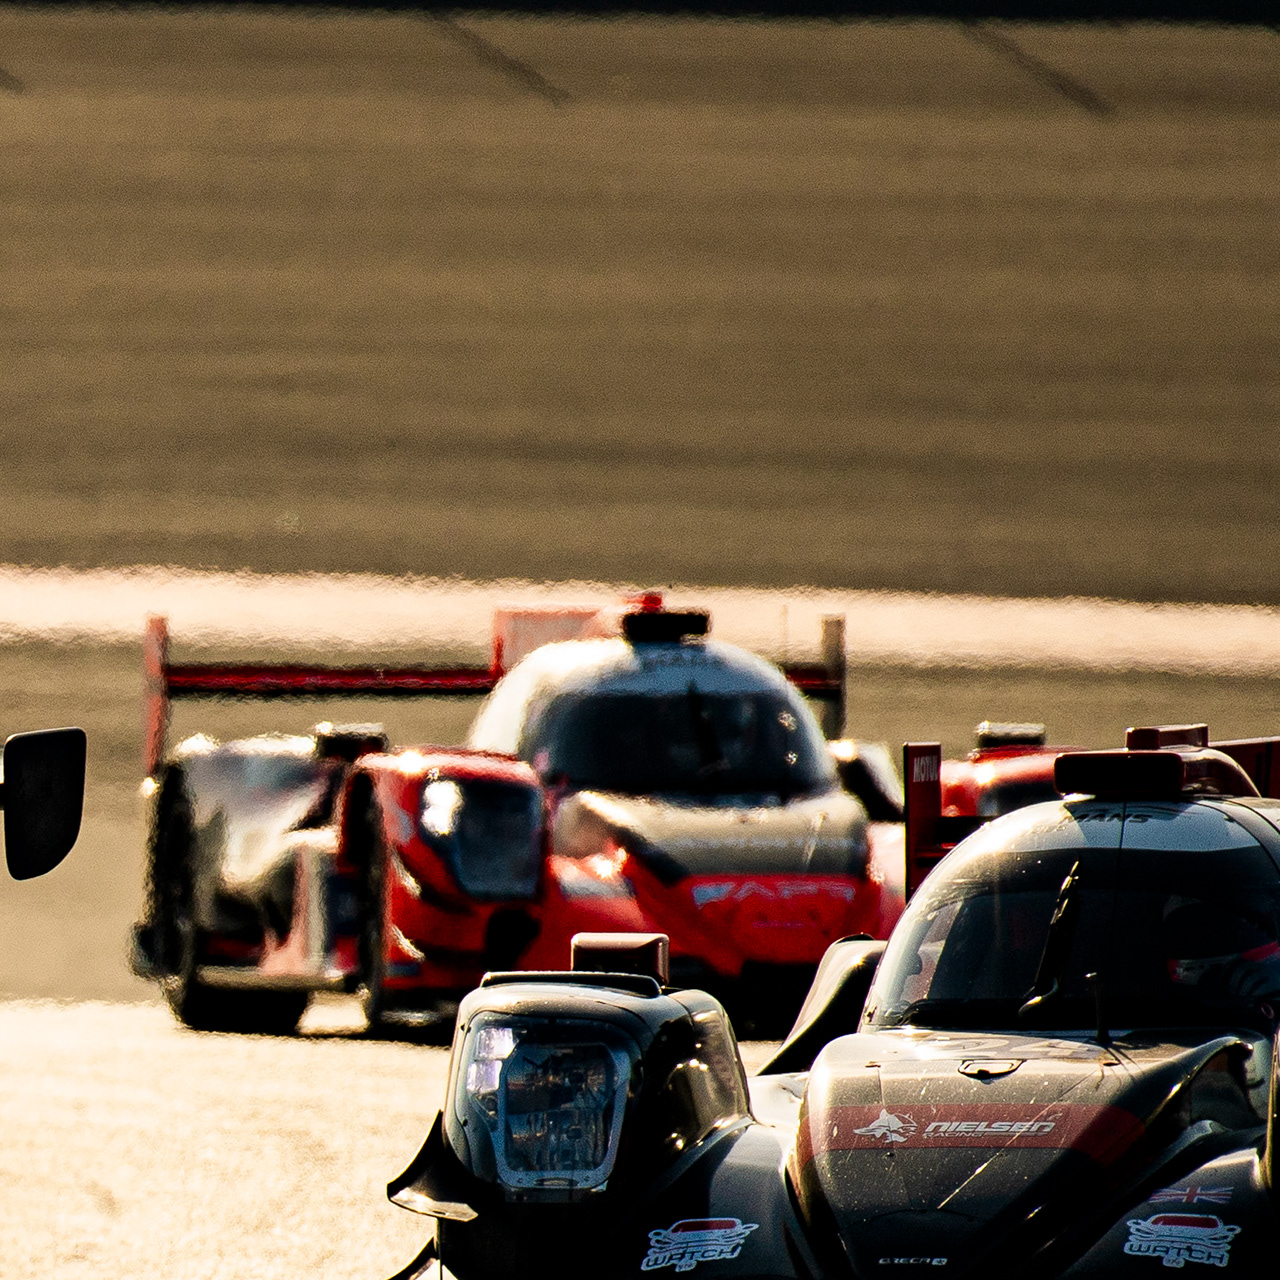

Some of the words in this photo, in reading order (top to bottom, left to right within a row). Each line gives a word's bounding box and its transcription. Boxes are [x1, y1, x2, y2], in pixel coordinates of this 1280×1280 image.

[925, 1121, 1056, 1132] NIELSEN
[646, 1244, 741, 1268] WATCH
[1129, 1243, 1225, 1265] WATCH
